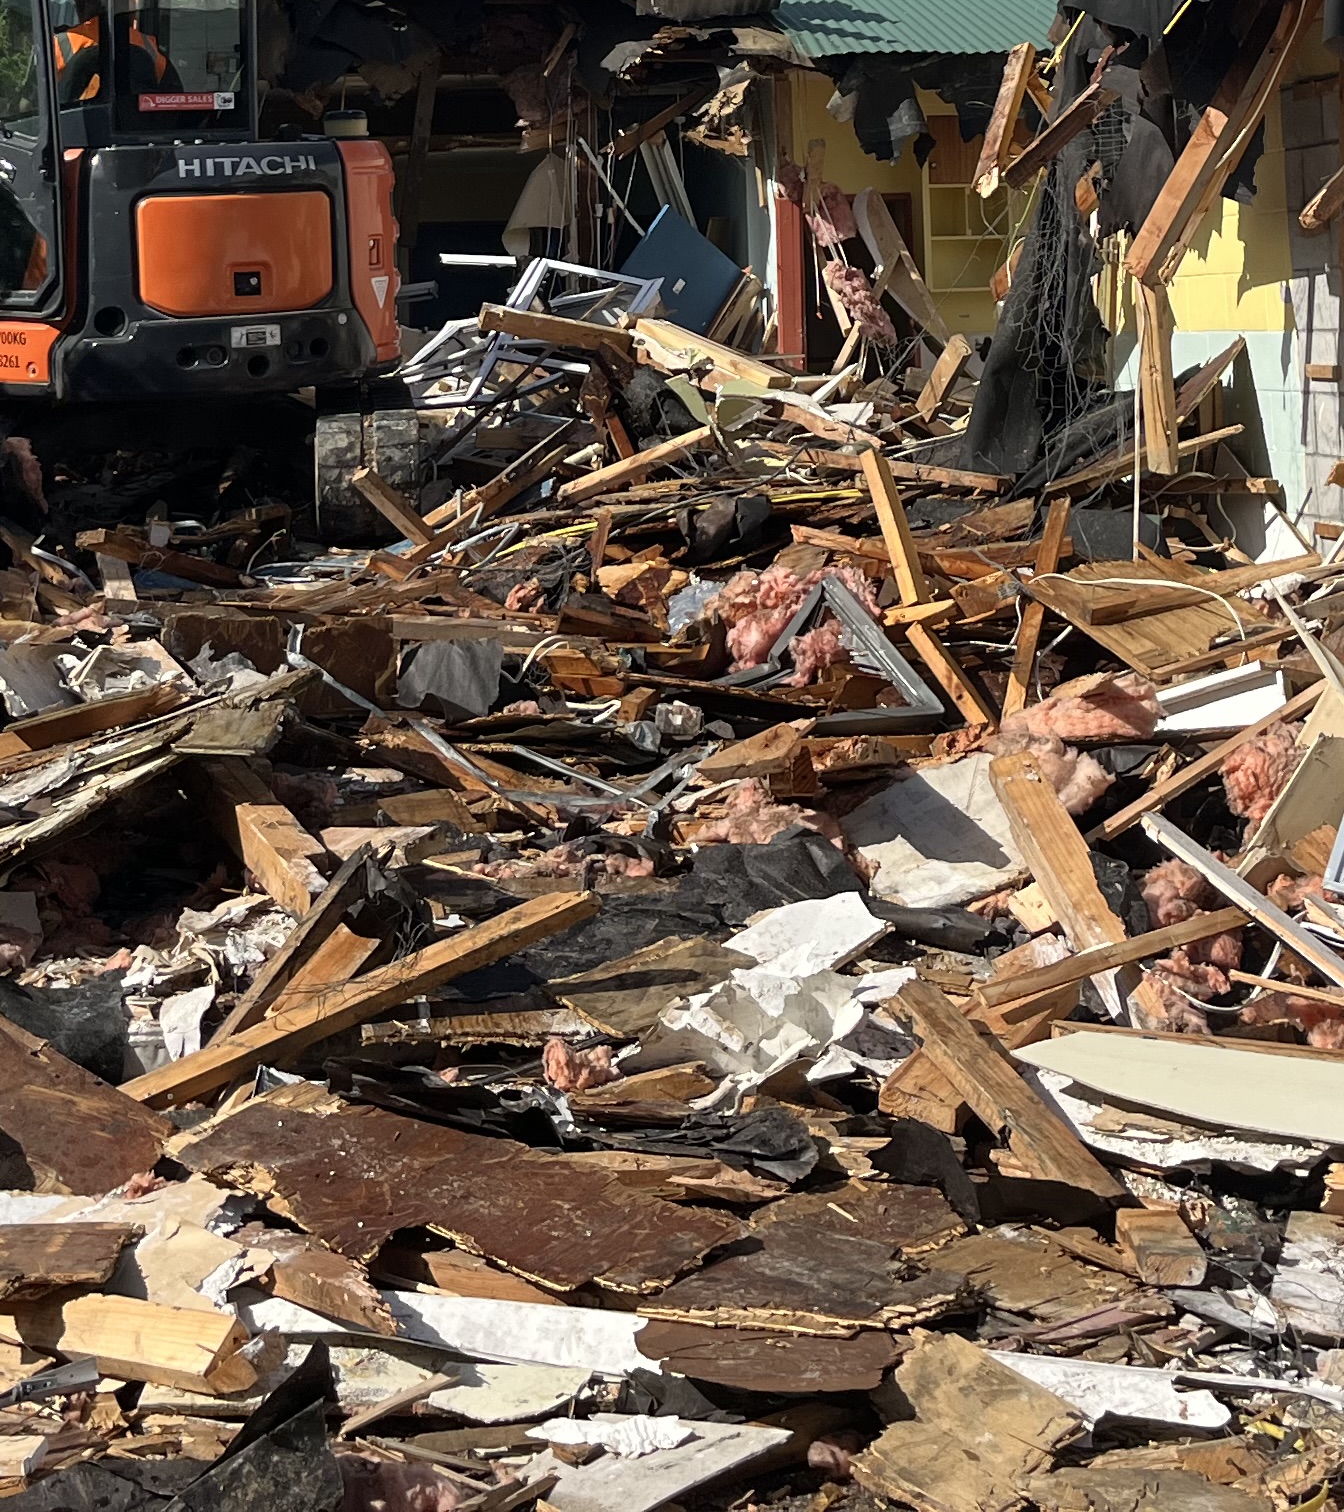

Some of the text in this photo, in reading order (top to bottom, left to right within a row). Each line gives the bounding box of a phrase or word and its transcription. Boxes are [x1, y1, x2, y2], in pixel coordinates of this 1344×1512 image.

[156, 95, 186, 104] DIGGER
[188, 95, 213, 103] SALES
[178, 155, 316, 178] HITACHI
